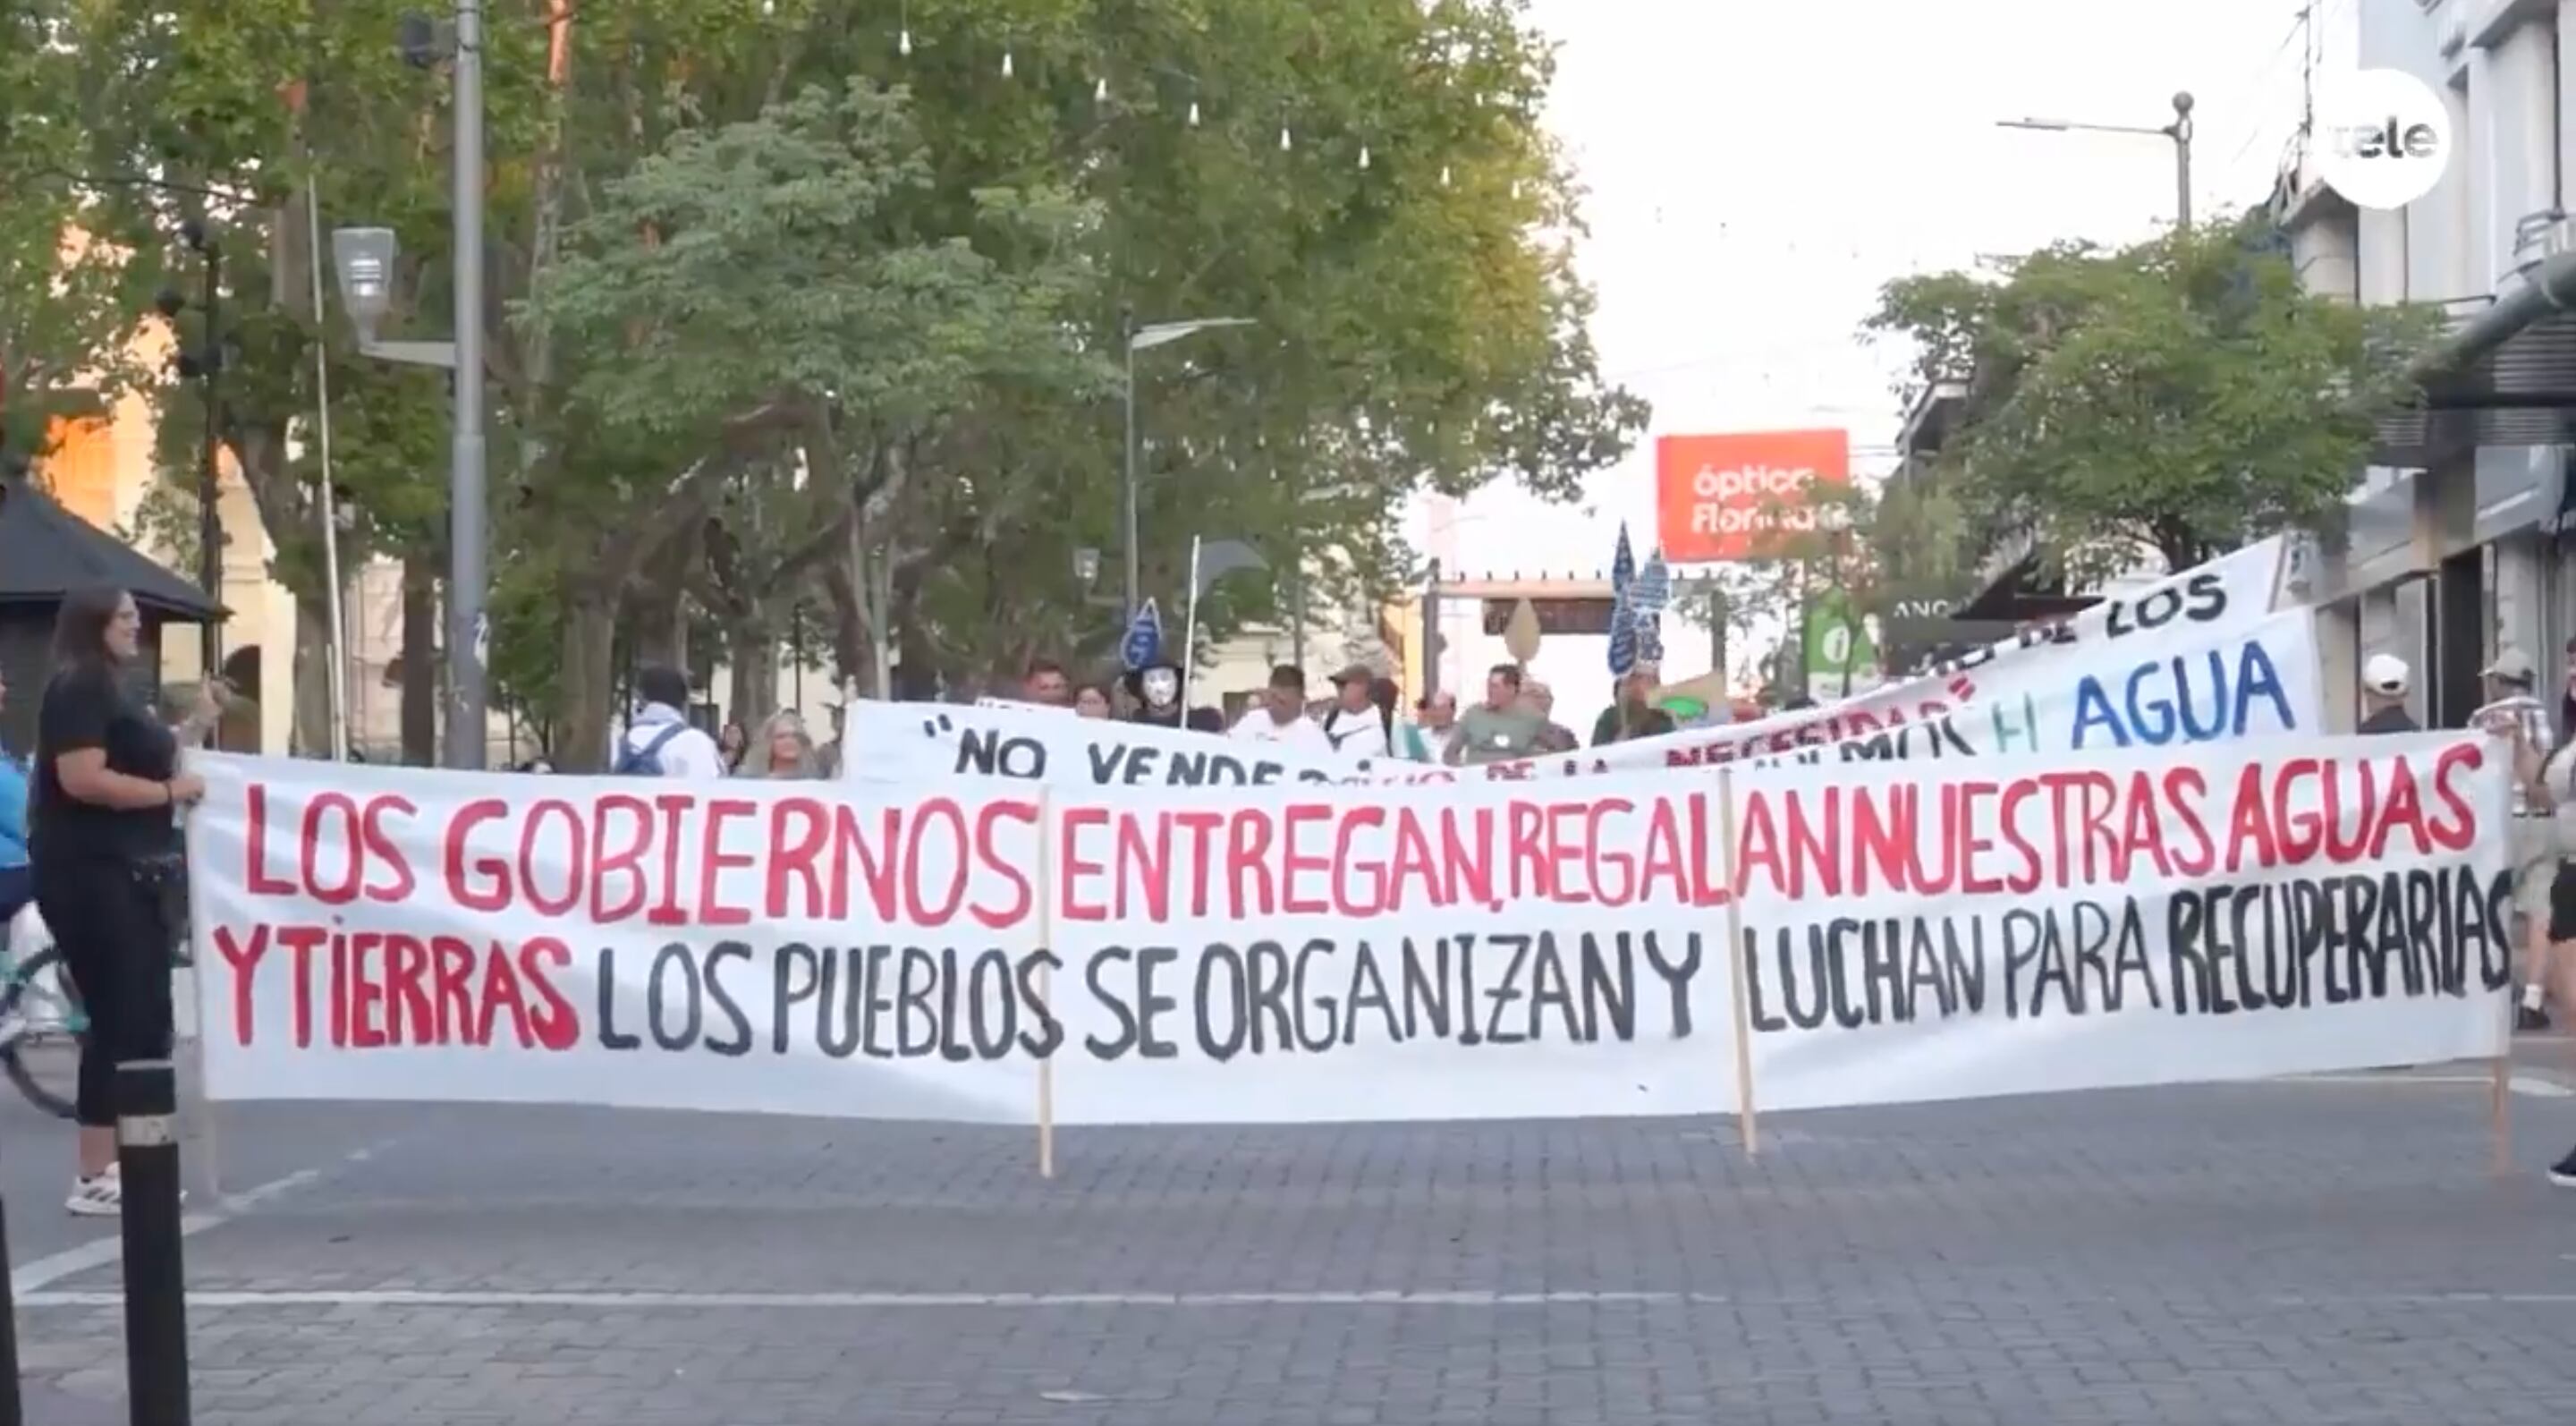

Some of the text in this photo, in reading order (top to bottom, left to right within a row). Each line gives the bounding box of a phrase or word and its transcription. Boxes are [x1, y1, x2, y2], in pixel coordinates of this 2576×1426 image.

[2106, 573, 2226, 638] LOS
[2072, 640, 2296, 750] AGUA
[245, 784, 417, 904] LOS
[443, 794, 1039, 928] GOBIERNOS
[1509, 785, 1841, 907] REGALAN
[1851, 765, 2216, 895] NUESTRAS
[2224, 742, 2483, 870] AGUAS
[213, 923, 270, 1047] Y
[597, 942, 753, 1057] LOS
[774, 944, 1064, 1062] PUEBLOS
[1085, 946, 1179, 1061] SE
[1195, 930, 1635, 1063] ORGANIZAN
[1643, 930, 1703, 1040] Y
[1743, 907, 1984, 1032] LUCHAN
[2003, 897, 2161, 1018] PARA
